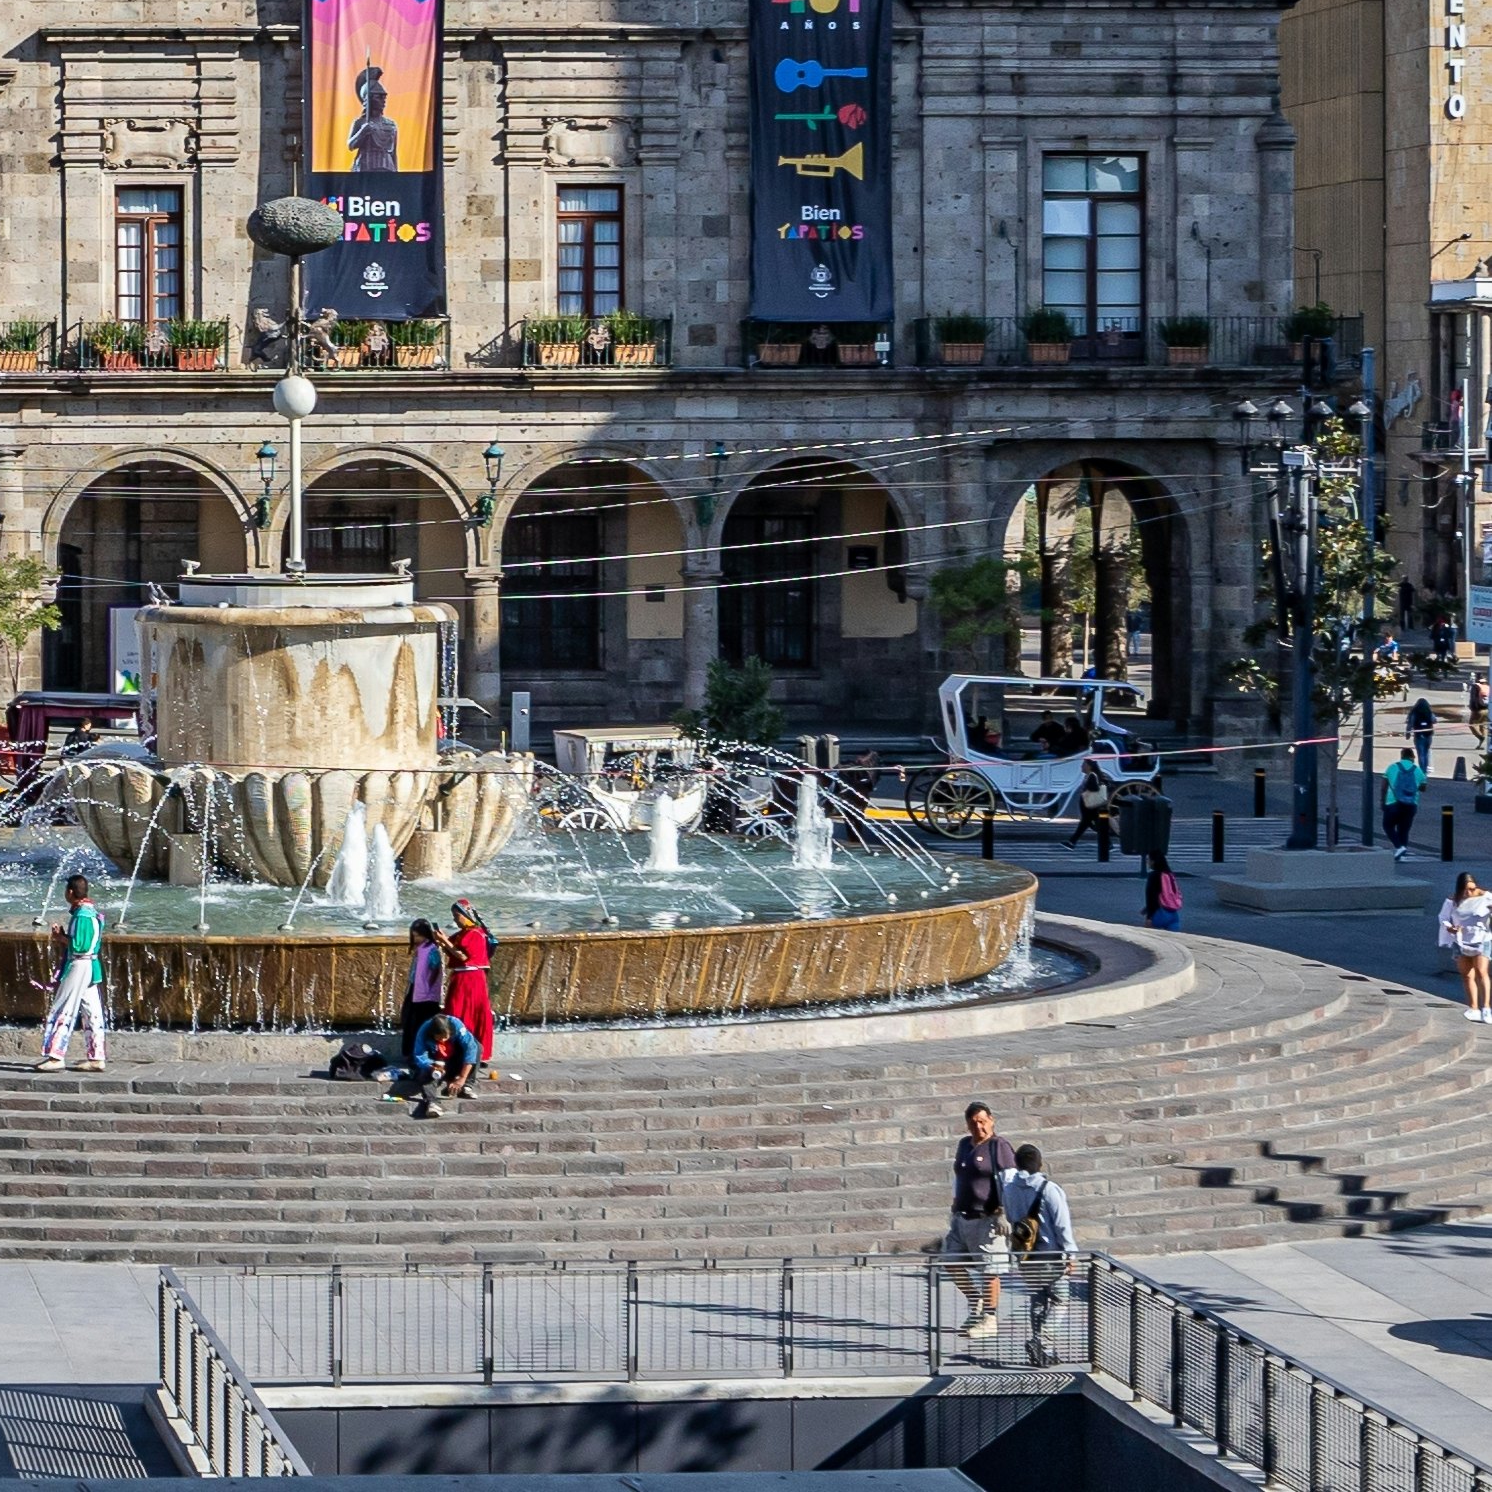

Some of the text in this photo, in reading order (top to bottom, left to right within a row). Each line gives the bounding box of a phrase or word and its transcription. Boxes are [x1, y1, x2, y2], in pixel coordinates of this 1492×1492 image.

[779, 19, 861, 30] AÑOS
[348, 196, 401, 217] Bien
[801, 204, 841, 221] Bien
[338, 218, 432, 243] PATÍOS
